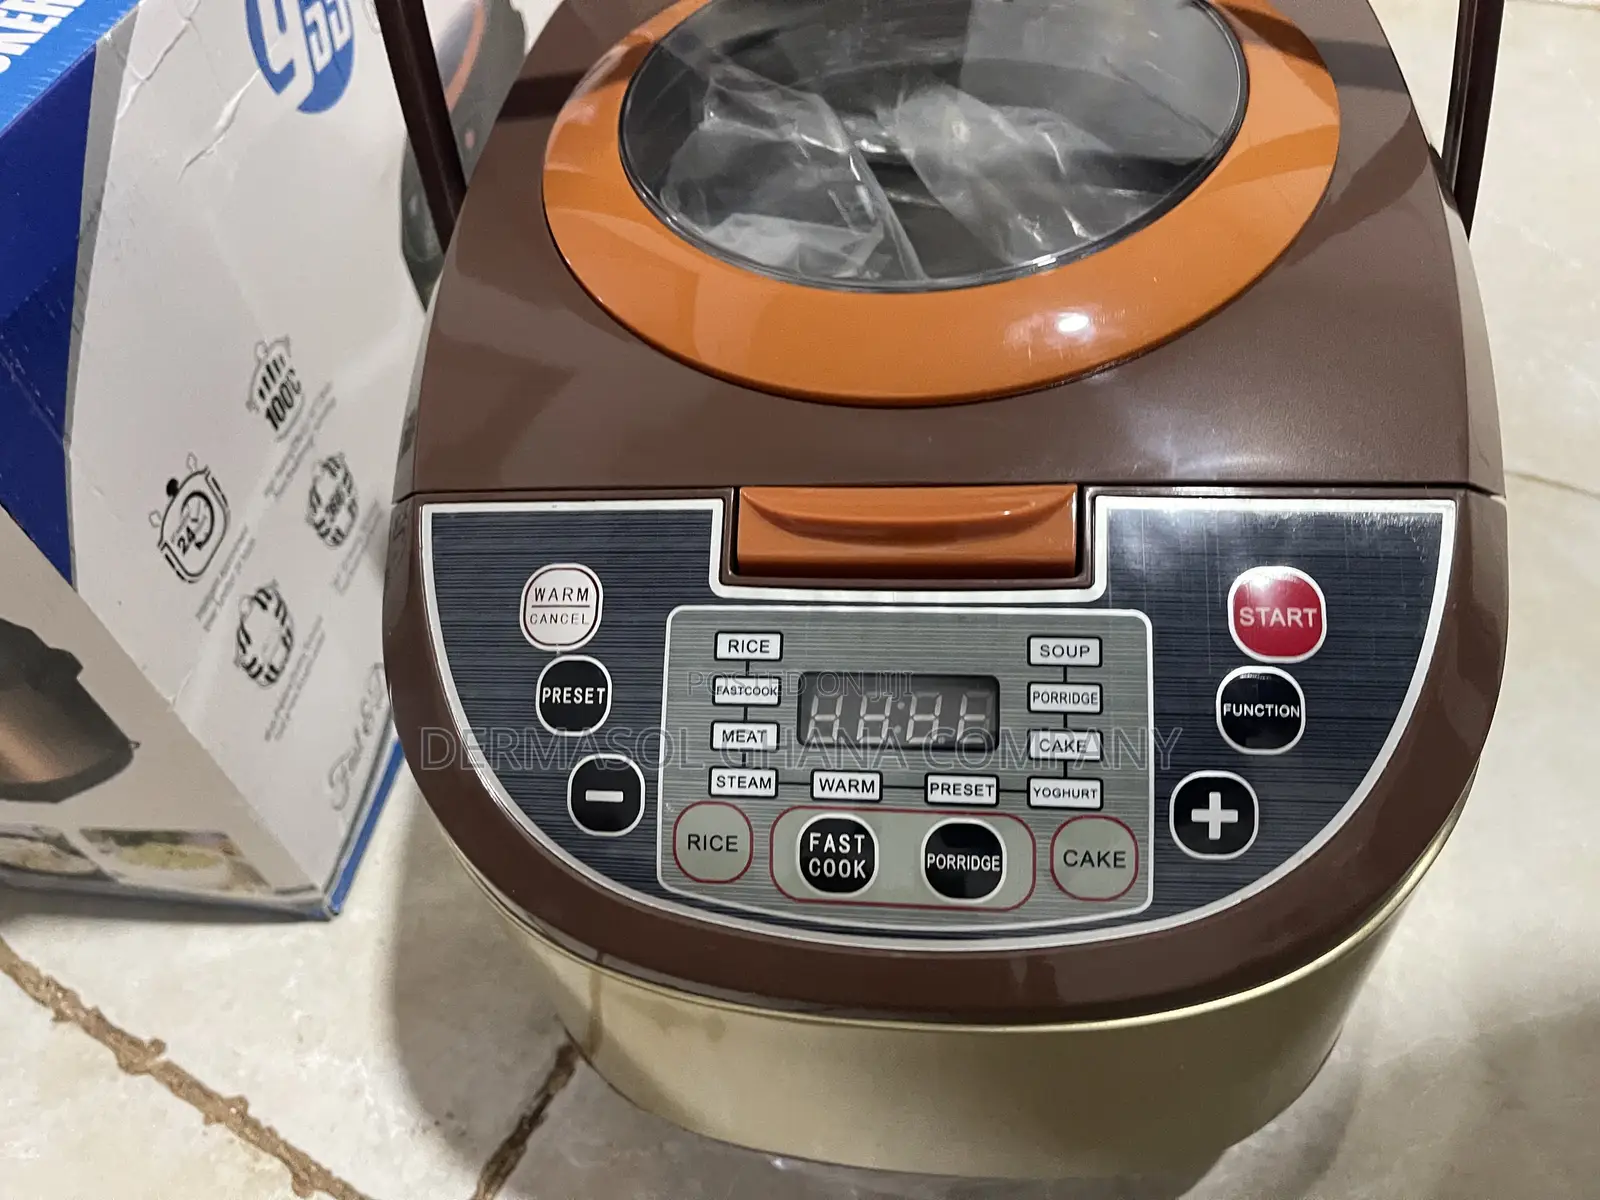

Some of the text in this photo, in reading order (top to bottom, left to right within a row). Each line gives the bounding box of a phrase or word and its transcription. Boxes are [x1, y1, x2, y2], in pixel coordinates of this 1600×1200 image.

[534, 586, 590, 602] WARM
[529, 612, 590, 626] CANCEL
[1239, 606, 1318, 628] START
[727, 638, 771, 655] RICE
[1038, 643, 1092, 659] SOUP
[542, 686, 606, 705] PRESET
[716, 685, 779, 697] FASTCOOK
[1032, 690, 1099, 706] PORRIDGE
[1223, 702, 1300, 719] FUNCTION
[721, 729, 768, 744] MEAT
[1038, 738, 1087, 754] CAKE
[715, 774, 773, 790] STEAM
[818, 777, 876, 794] WARM
[929, 782, 995, 799] PRESET
[1033, 786, 1098, 801] YOGHURT
[686, 834, 739, 852] RICE
[808, 832, 866, 854] FAST
[926, 852, 1001, 873] PORRIDGE
[1062, 850, 1127, 869] CAKE
[807, 857, 867, 880] COOK
